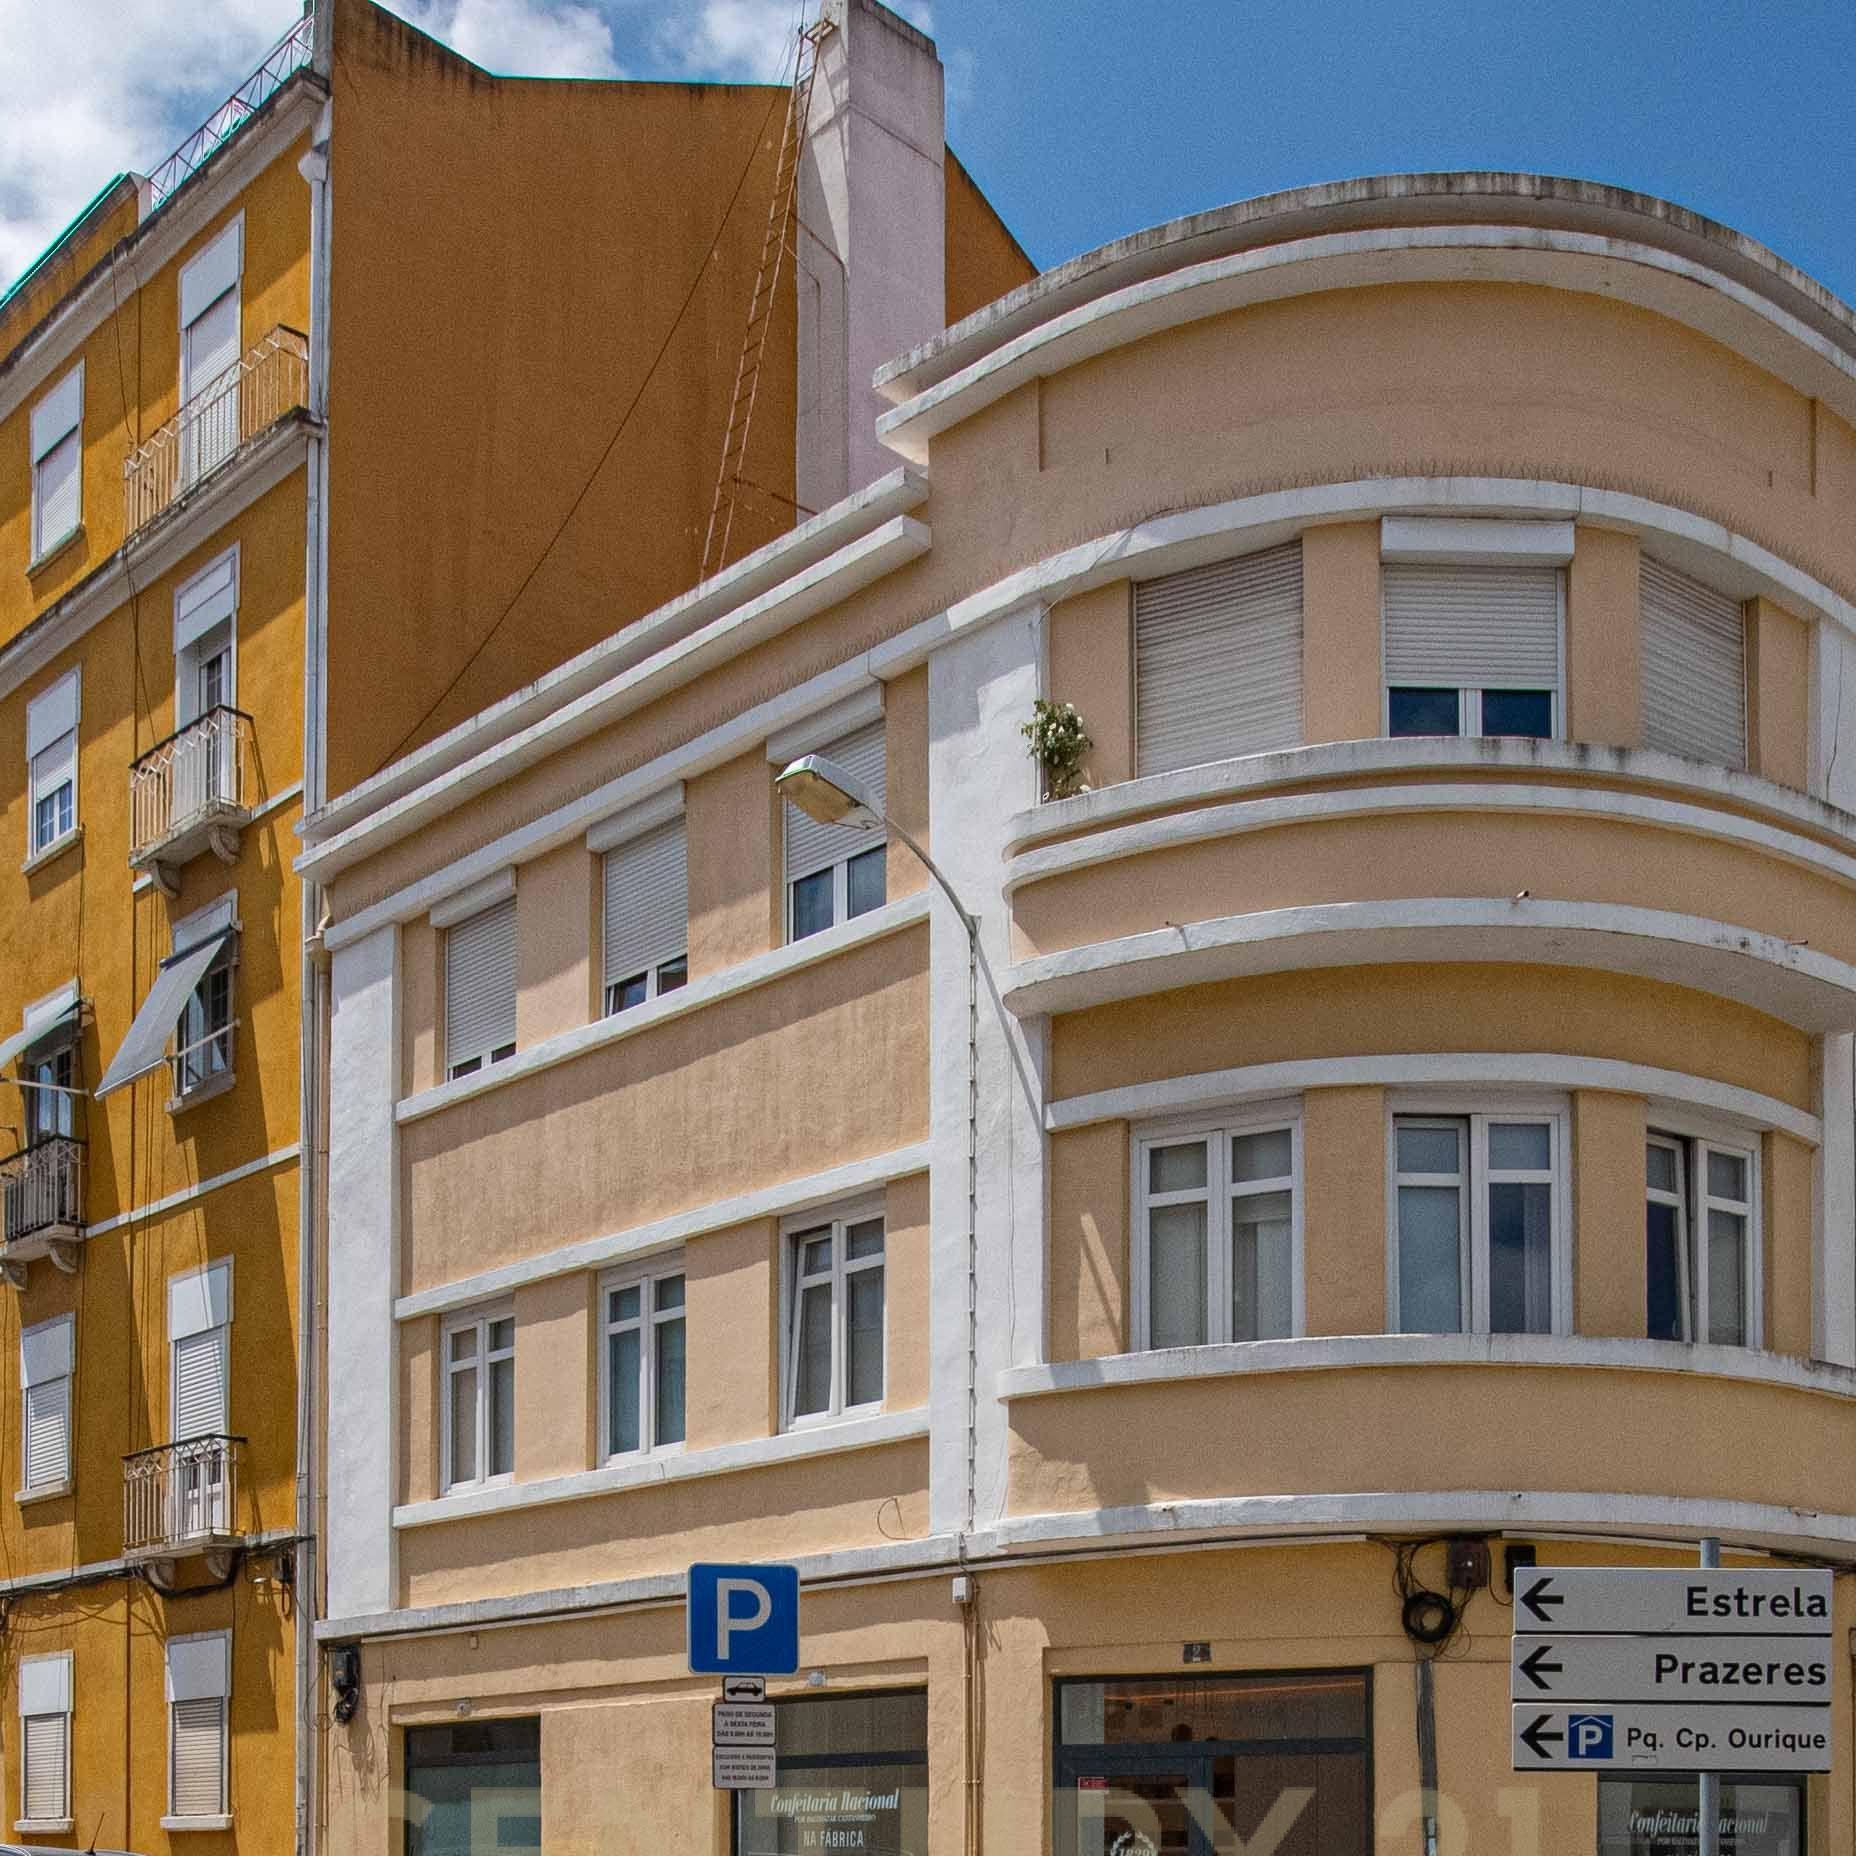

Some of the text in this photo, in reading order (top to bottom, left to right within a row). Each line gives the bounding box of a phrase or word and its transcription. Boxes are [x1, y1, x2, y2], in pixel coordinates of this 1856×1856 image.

[1686, 1586, 1828, 1618] Estrela
[716, 1578, 772, 1660] P
[1655, 1654, 1827, 1686] Prazeres
[1578, 1725, 1827, 1756] P Pq. Cp. Ourique
[770, 1787, 900, 1817] Confeitaria Nacional
[803, 1827, 864, 1848] NA FÁBRICA
[1629, 1809, 1769, 1839] Confeitari acional
